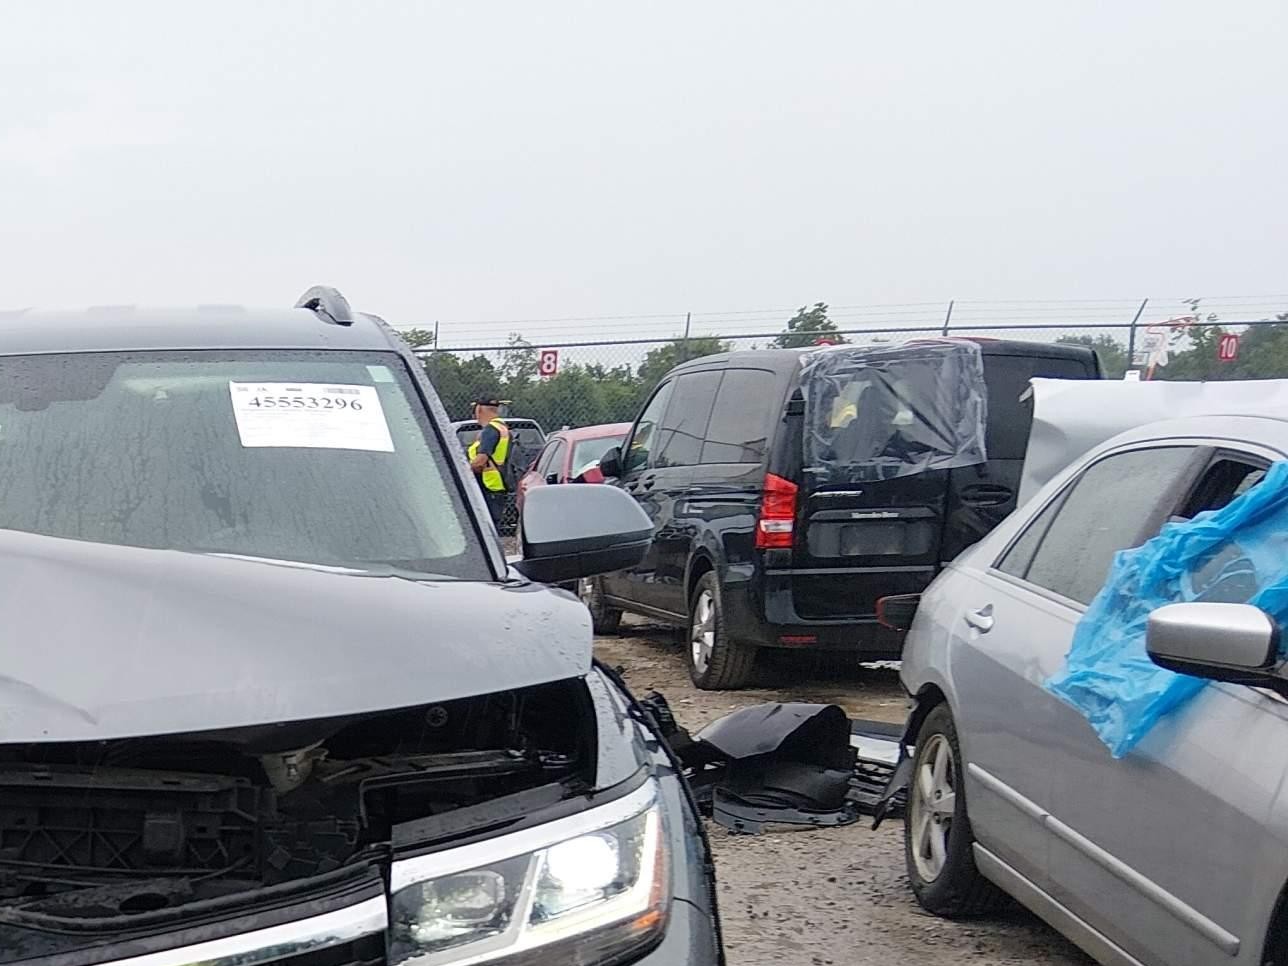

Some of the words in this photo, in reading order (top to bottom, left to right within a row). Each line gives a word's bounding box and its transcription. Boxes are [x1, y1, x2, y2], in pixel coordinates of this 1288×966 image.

[1220, 337, 1237, 358] 10
[542, 353, 556, 373] 8
[248, 395, 363, 411] 45553296
